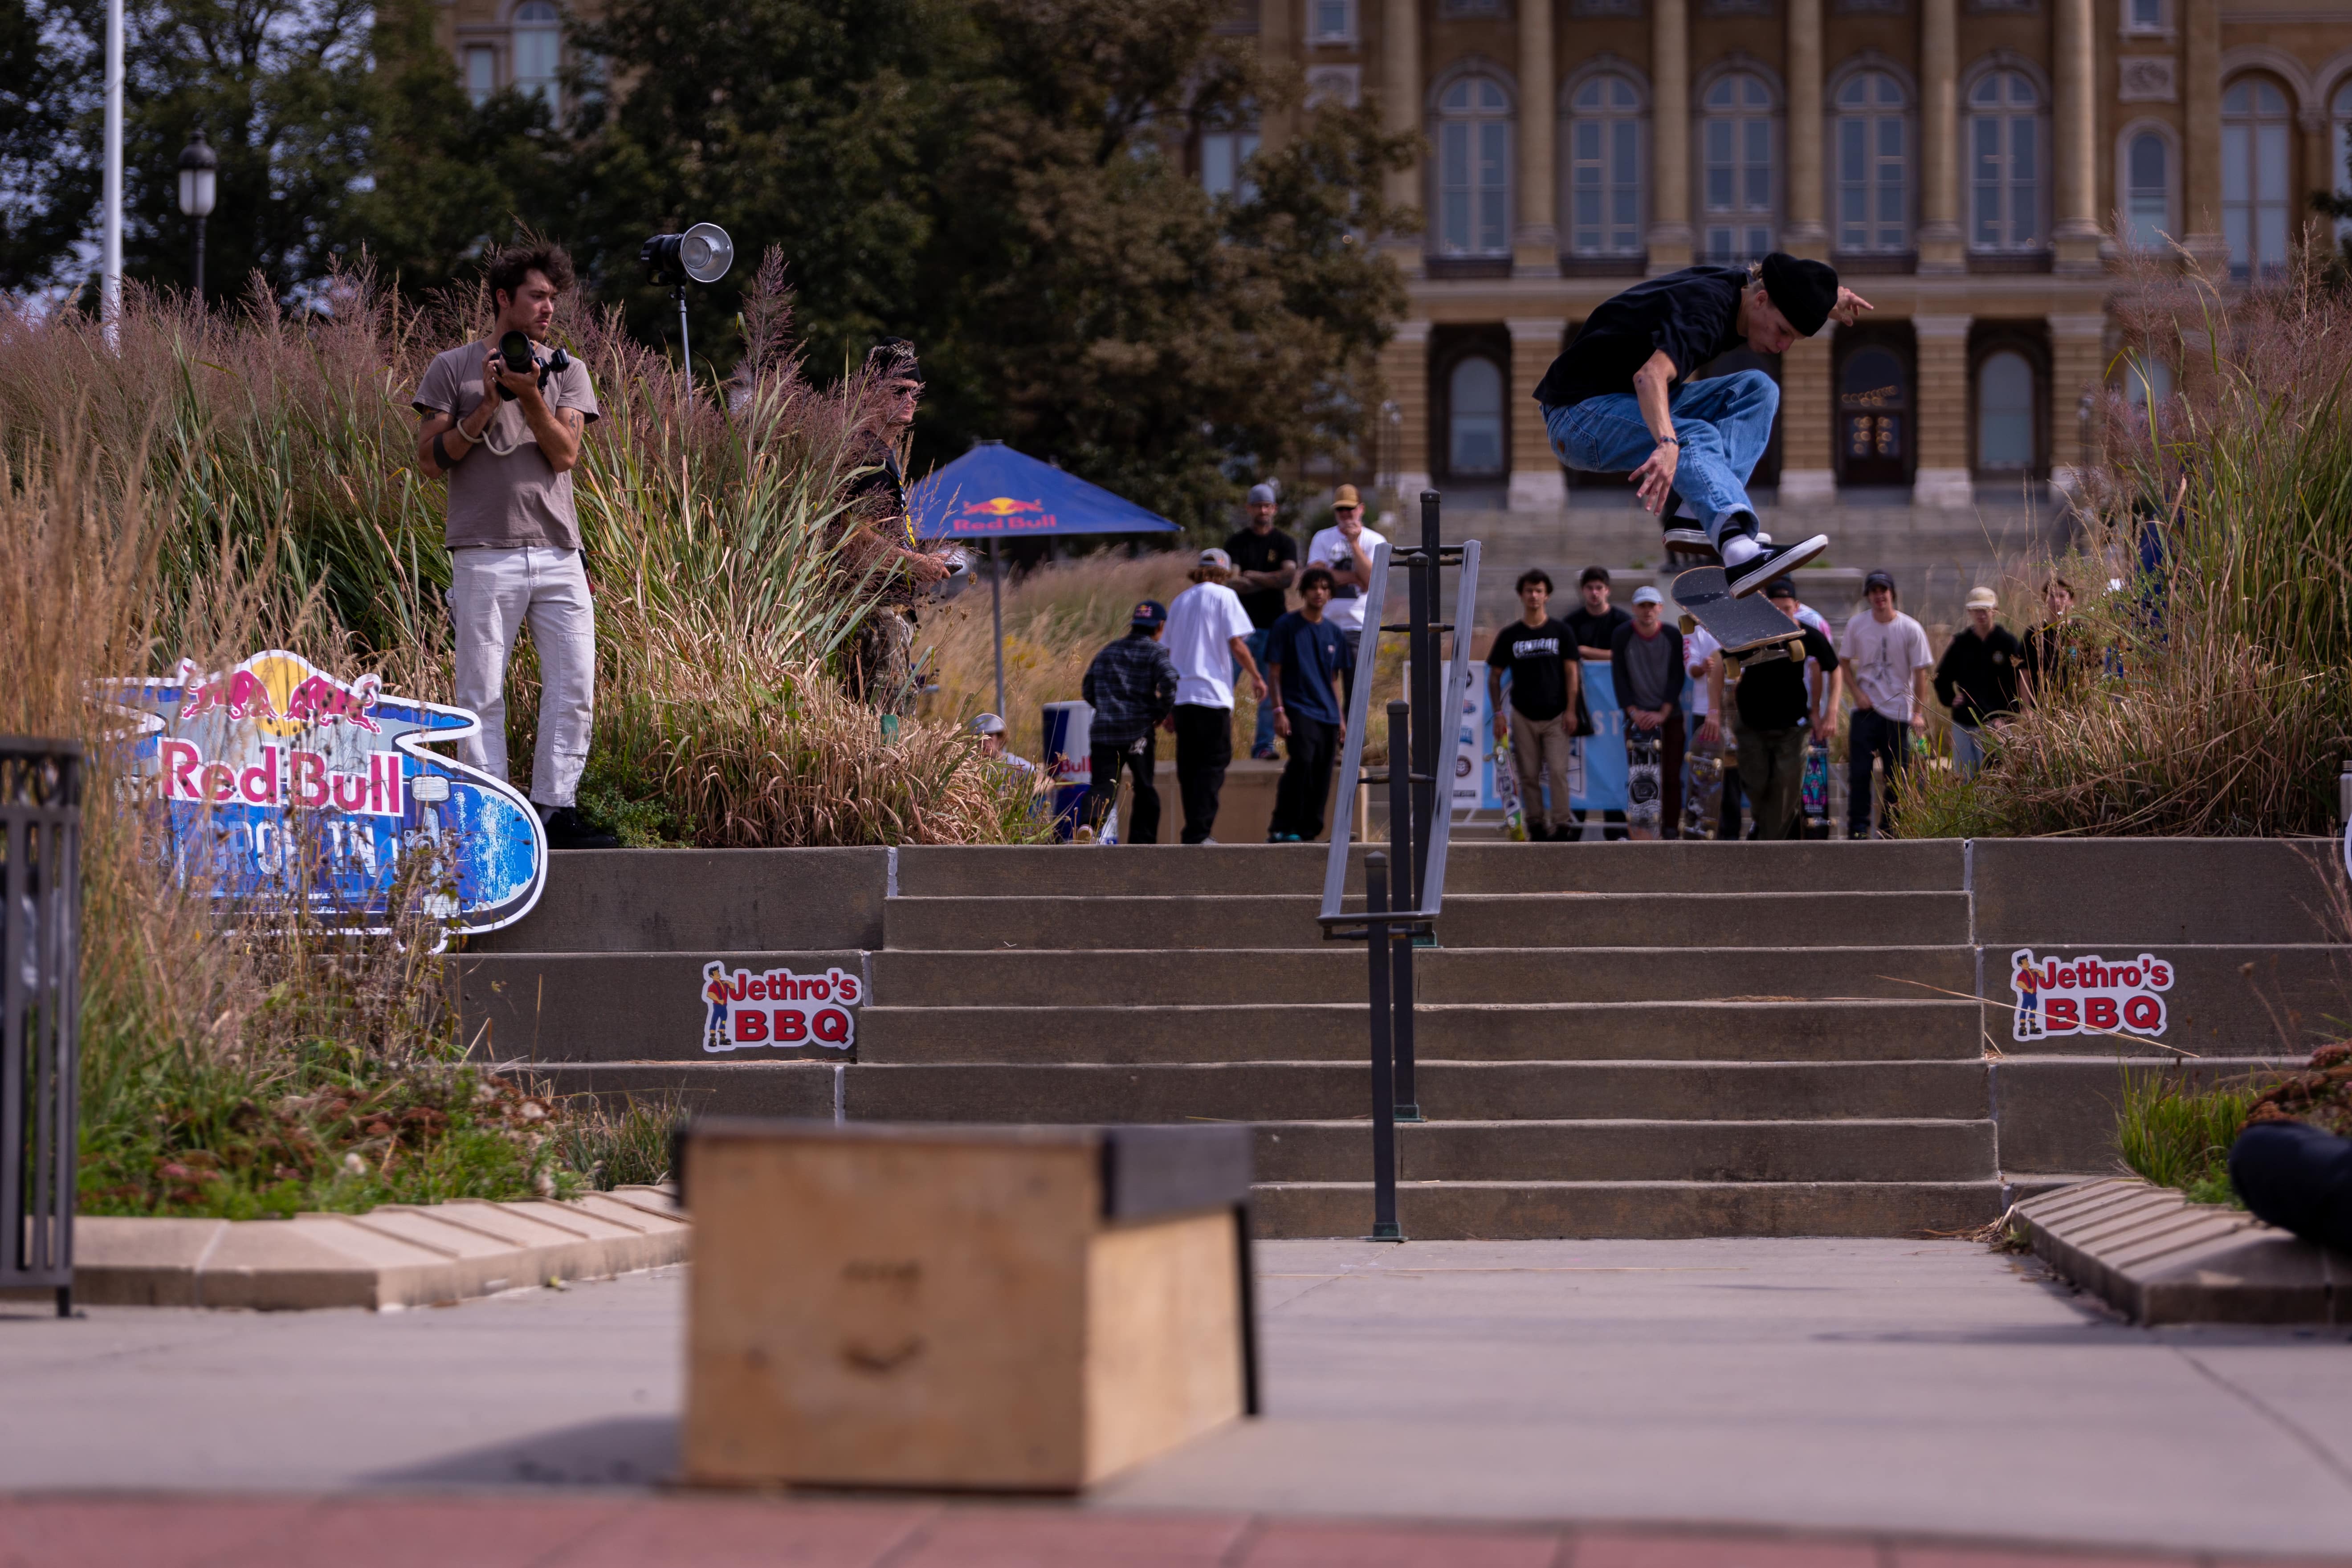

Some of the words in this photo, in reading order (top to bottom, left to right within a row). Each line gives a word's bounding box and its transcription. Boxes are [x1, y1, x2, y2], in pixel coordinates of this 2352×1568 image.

[953, 517, 1004, 532] Red
[1007, 514, 1056, 529] Bull
[161, 740, 277, 803] Red
[291, 750, 400, 813] Bull
[1061, 755, 1092, 773] Bull
[729, 972, 857, 1001] Jethro's
[2038, 959, 2169, 990] Jethro's
[734, 1008, 849, 1045] BBQ
[2045, 995, 2162, 1031] BBQ
